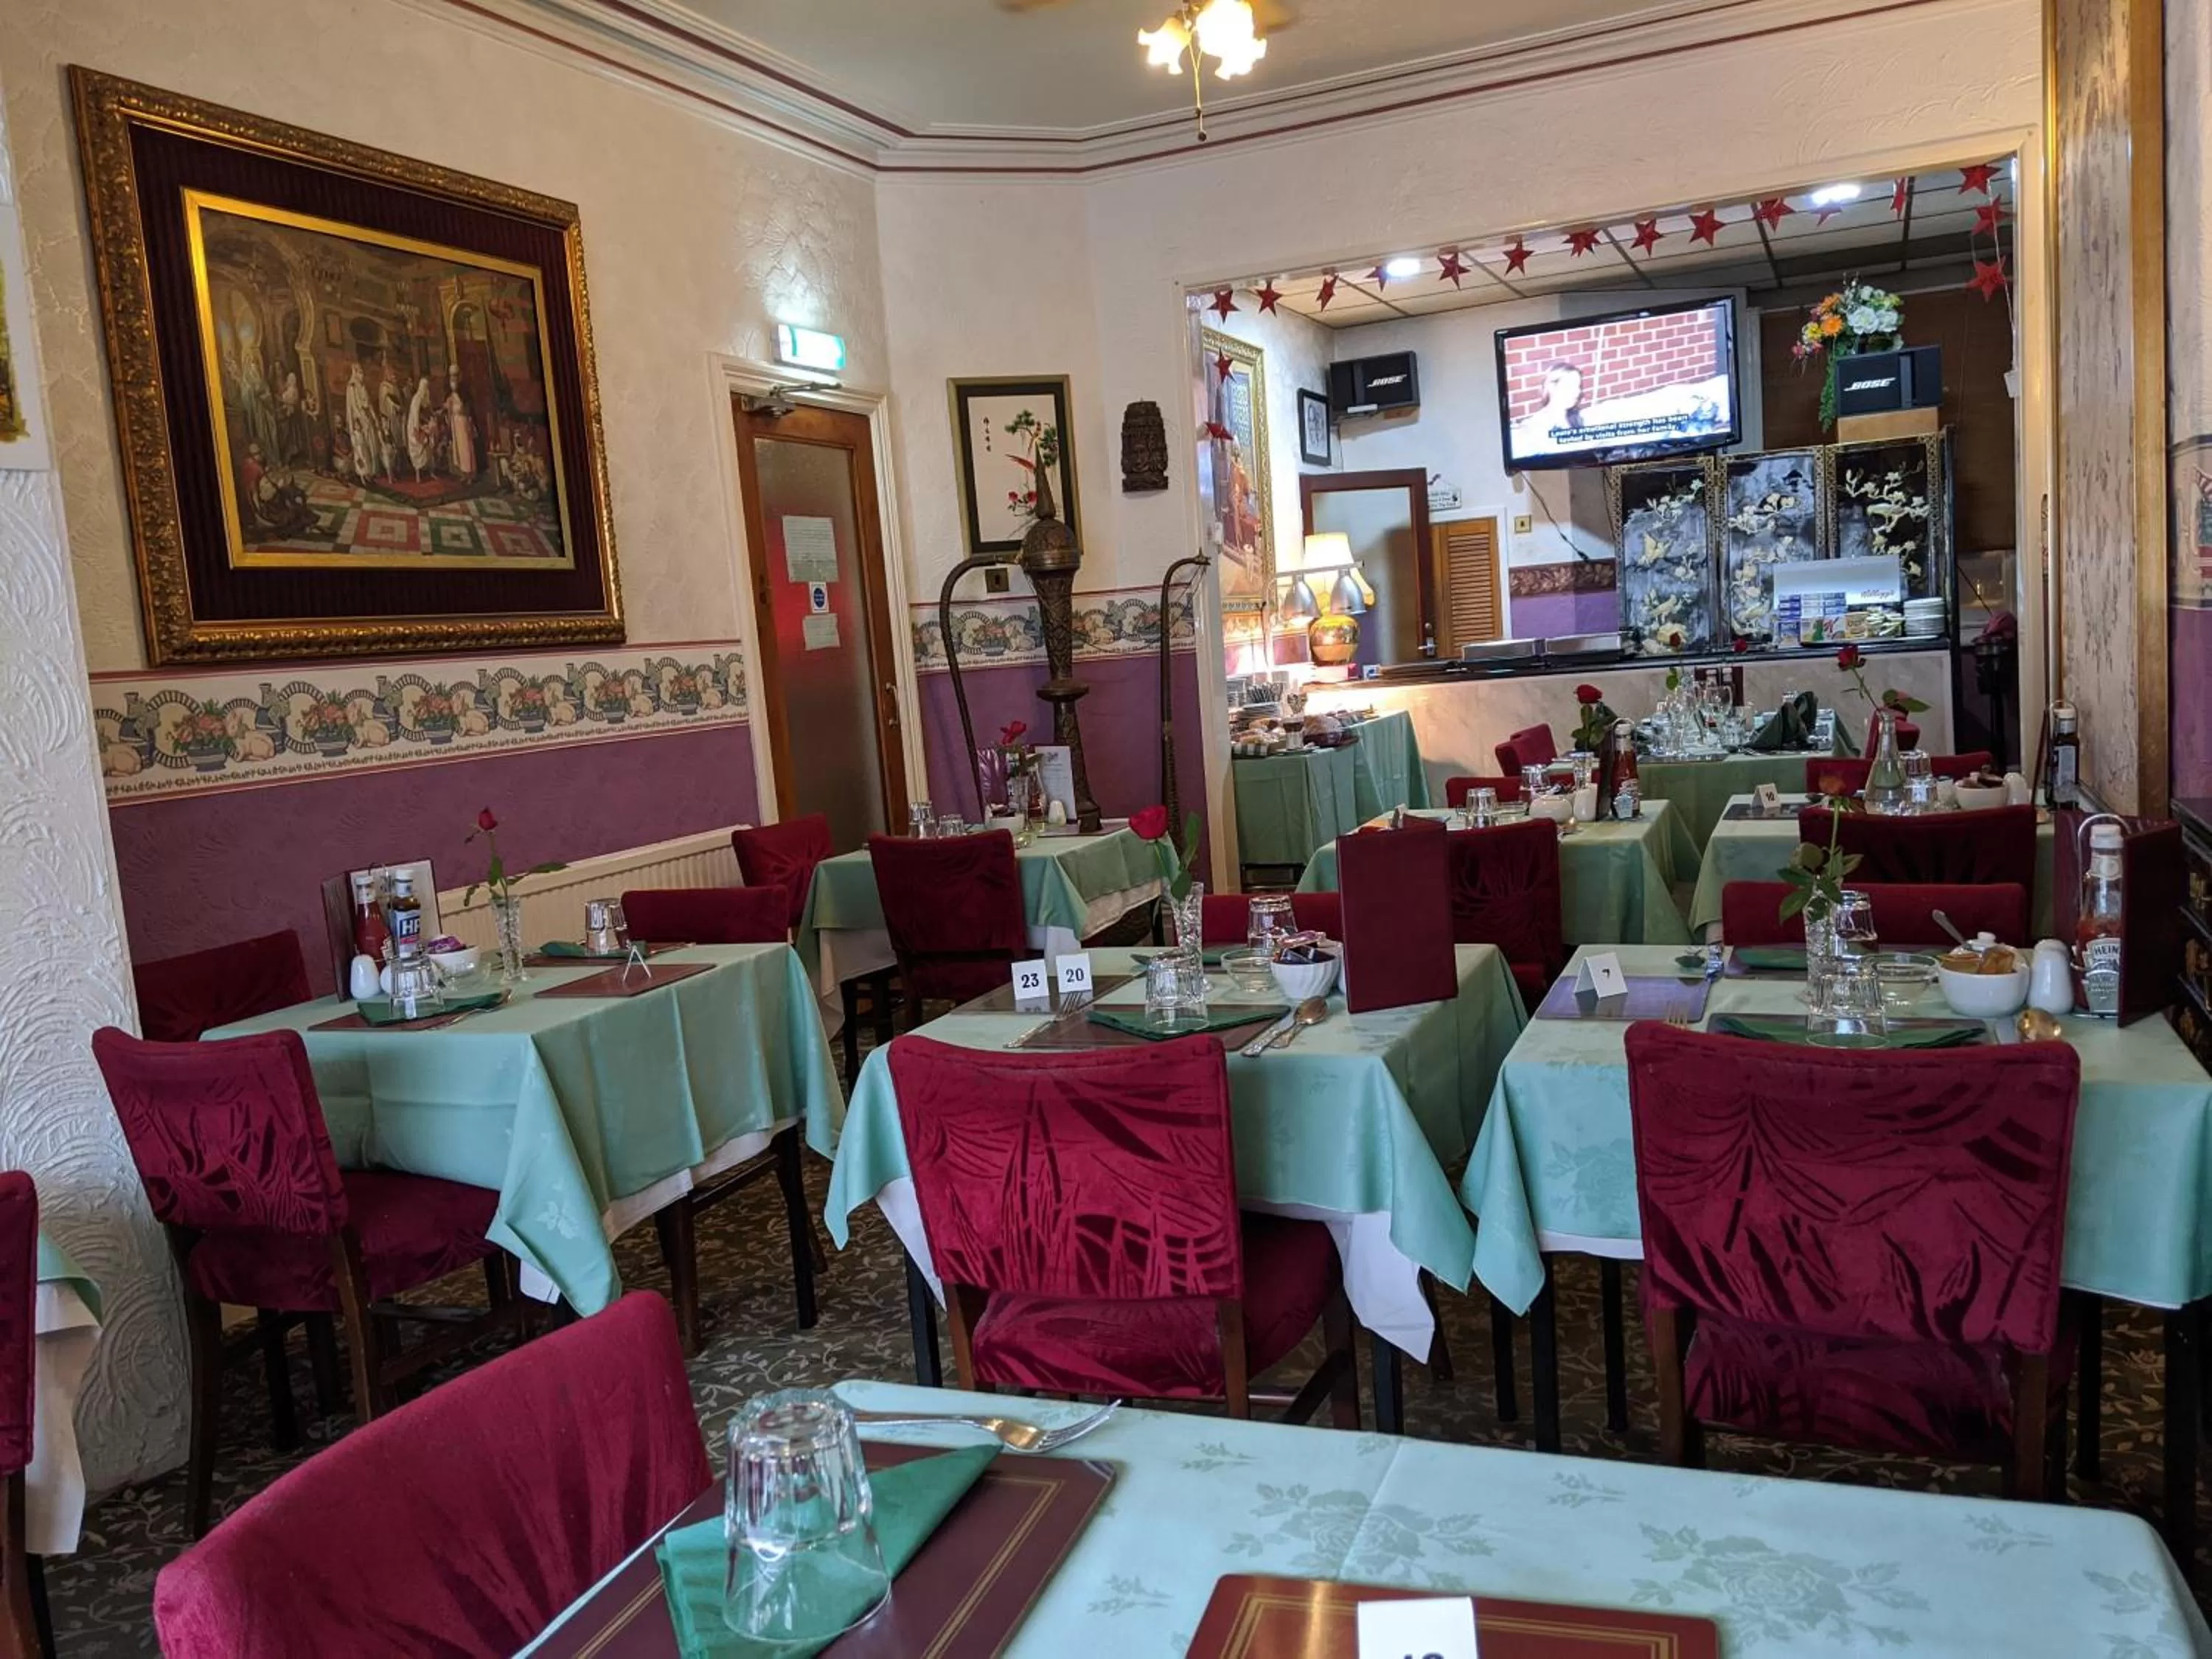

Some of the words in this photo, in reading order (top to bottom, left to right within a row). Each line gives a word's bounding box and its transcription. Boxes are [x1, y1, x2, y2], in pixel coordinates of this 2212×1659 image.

[1367, 374, 1407, 387] BOSE
[1843, 377, 1896, 392] BOSE
[2093, 945, 2120, 956] HEIN
[1065, 967, 1085, 983] 20
[1601, 968, 1610, 979] 7
[1020, 973, 1039, 989] 23
